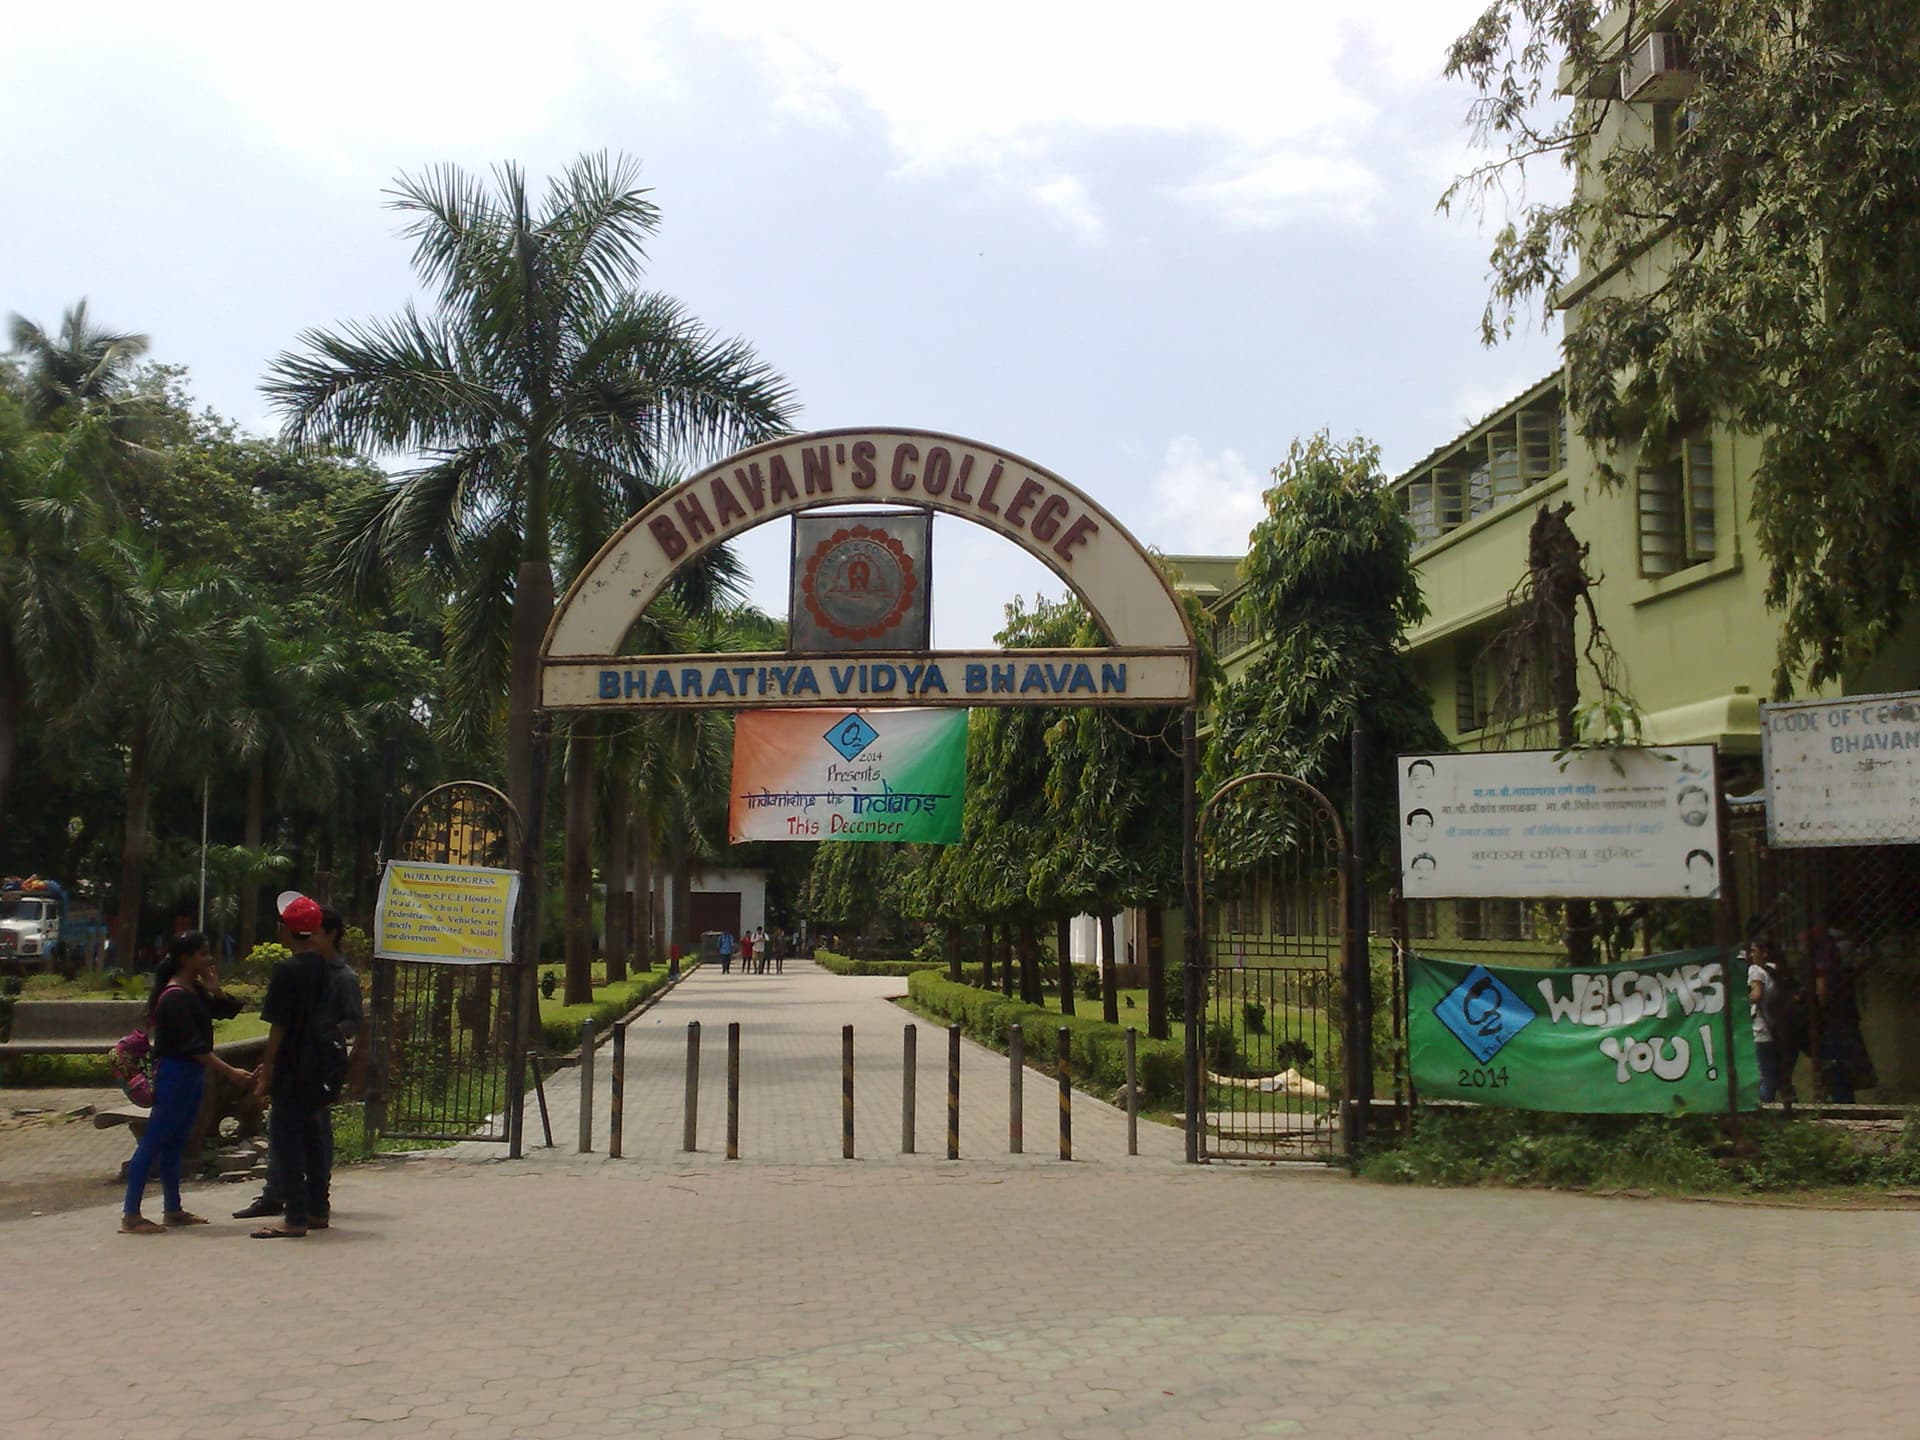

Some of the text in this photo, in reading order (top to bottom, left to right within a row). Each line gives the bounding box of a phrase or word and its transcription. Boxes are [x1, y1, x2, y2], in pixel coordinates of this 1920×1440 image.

[647, 440, 1099, 562] BHAVAN'S COLLEGE
[599, 662, 1126, 699] BHARATIYA VIDYA BHAVAN
[1773, 711, 1819, 733] CODE
[1828, 708, 1851, 728] OF
[858, 752, 883, 762] 2014
[827, 764, 881, 783] Presents
[787, 813, 904, 835] This December
[403, 871, 496, 886] WORK IN PROGRESS
[388, 909, 433, 920] Pedestrians
[448, 916, 482, 926] Vehicles
[428, 904, 463, 913] School
[1458, 1066, 1510, 1089] 2014
